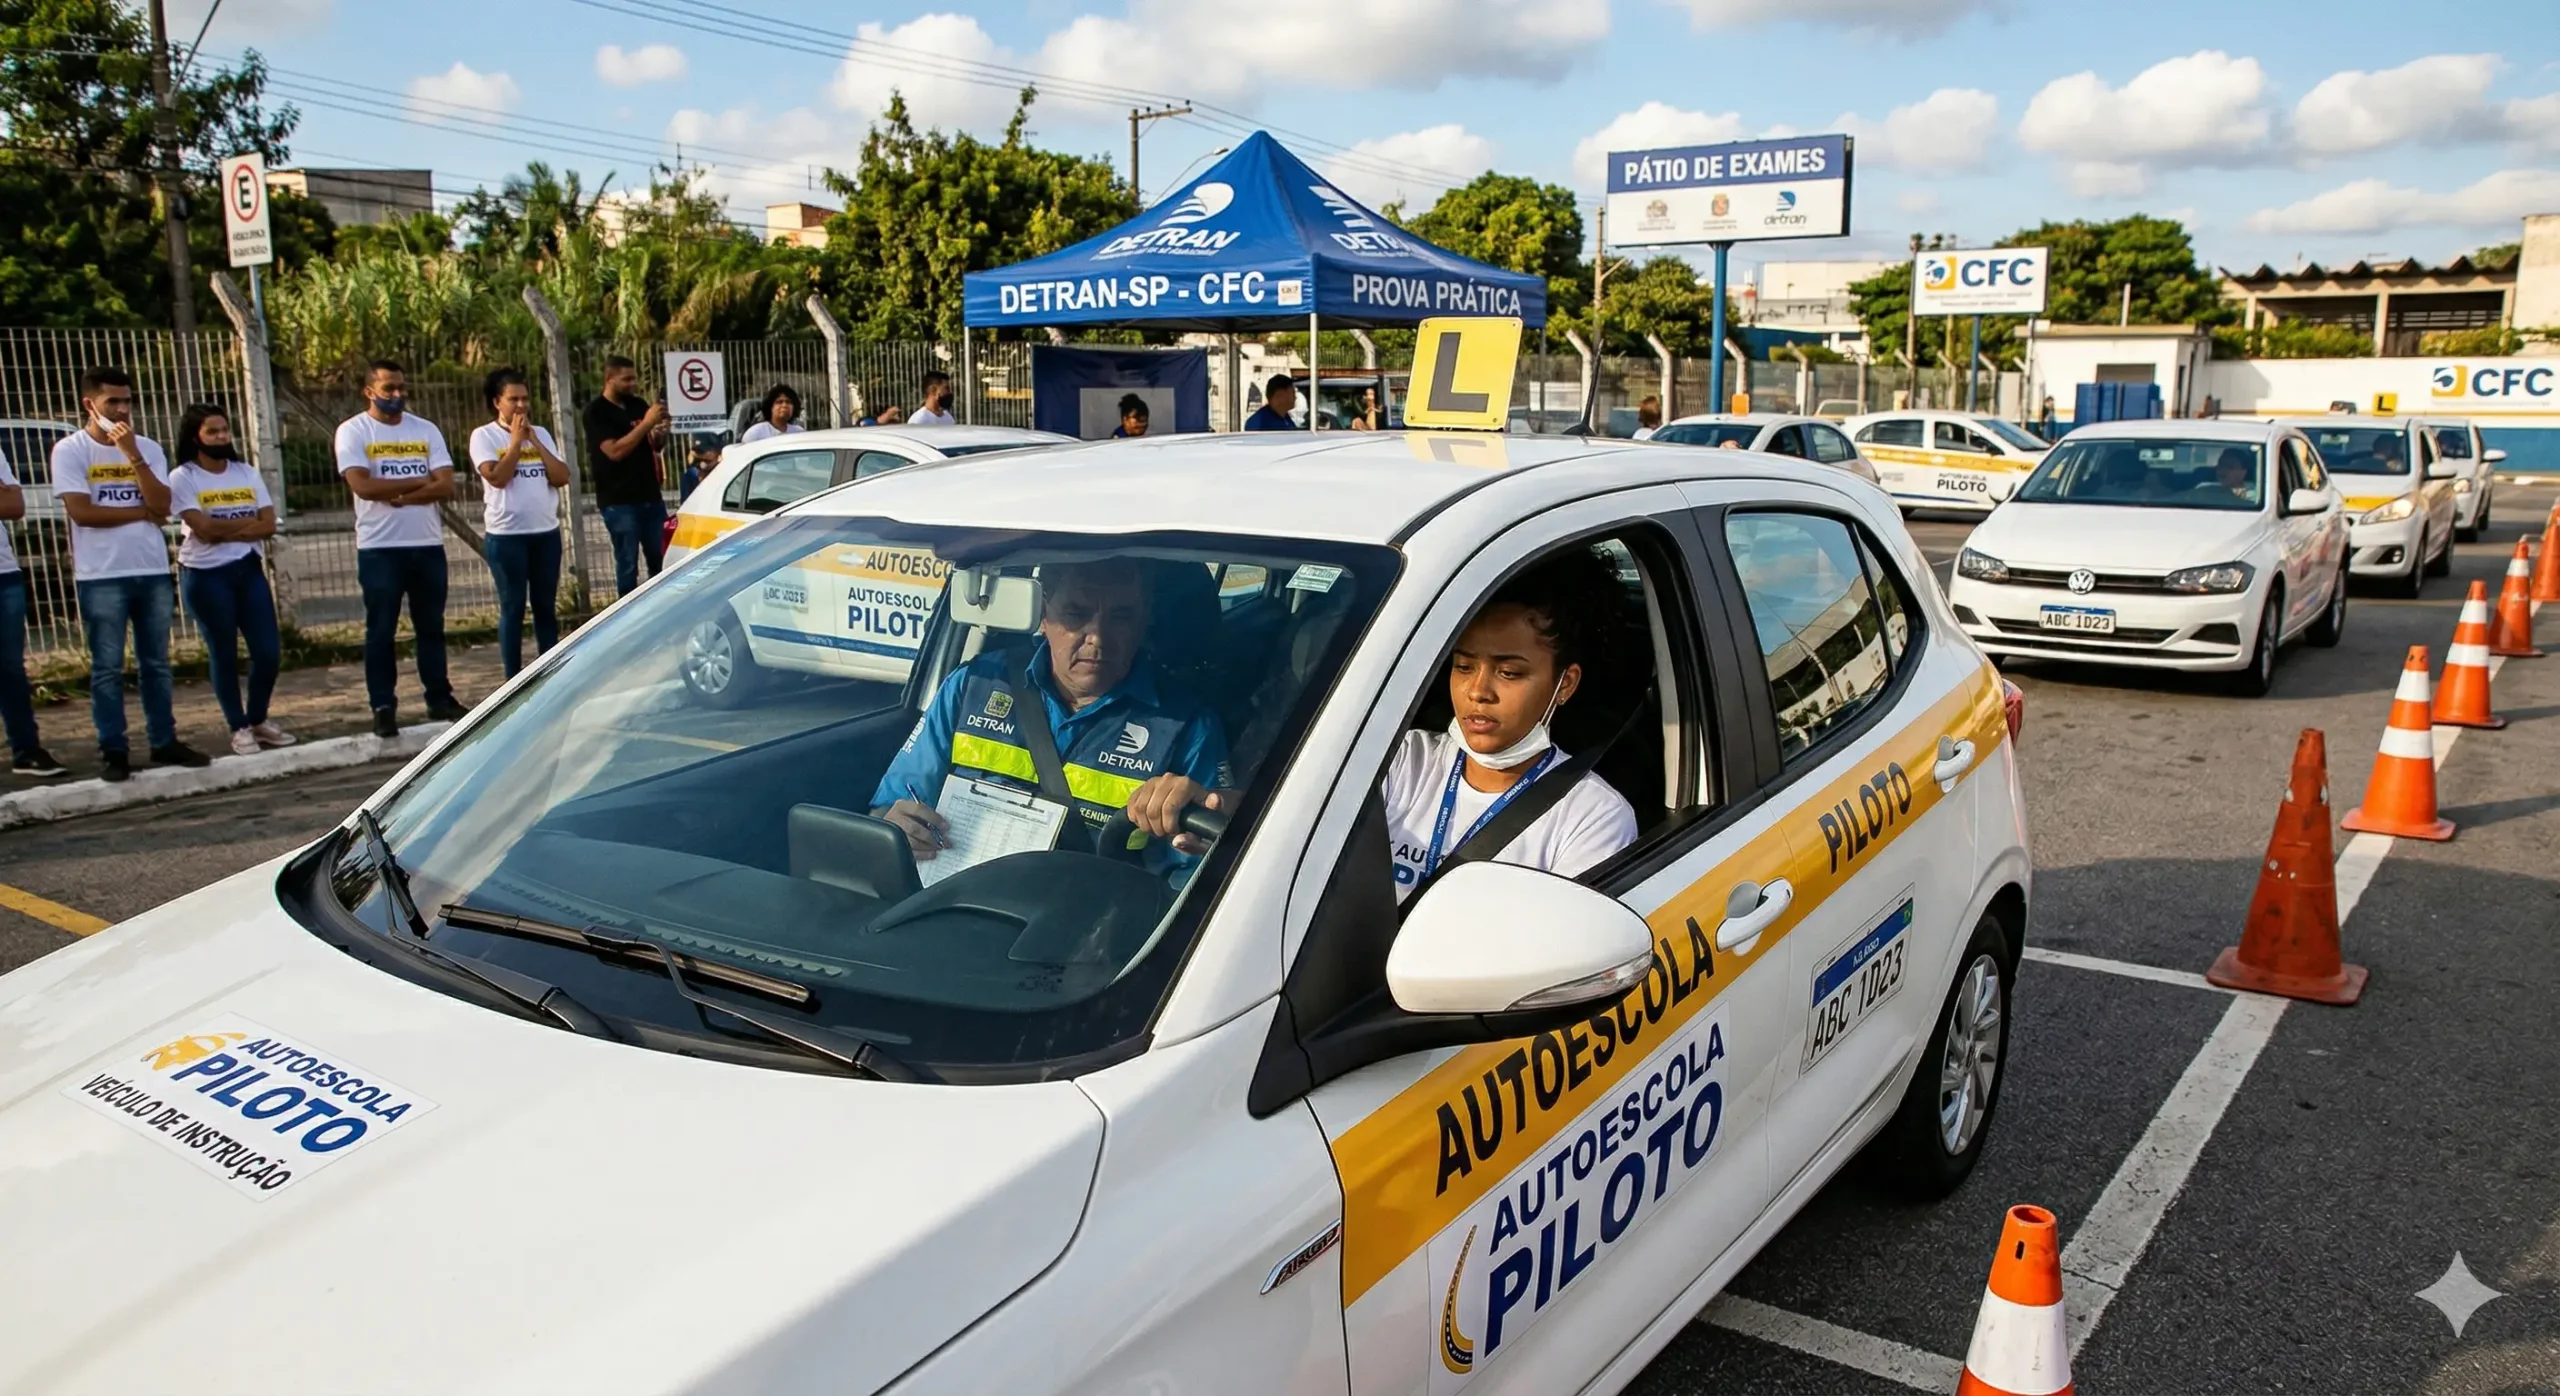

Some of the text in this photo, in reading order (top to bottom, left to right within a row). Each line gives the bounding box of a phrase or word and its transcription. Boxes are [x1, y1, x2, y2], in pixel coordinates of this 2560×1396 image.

[1624, 148, 1826, 185] PÁTIO DE EXAMES
[238, 175, 252, 209] E
[1099, 227, 1241, 254] DETRAN
[1961, 258, 2034, 287] CFC
[1000, 275, 1170, 314] DETRAN-SP
[1198, 271, 1265, 305] CFC
[1353, 274, 1522, 316] PROVA PRÁTICA
[688, 368, 705, 392] E
[1427, 332, 1490, 413] L
[2472, 368, 2554, 397] CFC
[2376, 396, 2394, 412] L
[381, 464, 427, 476] PILOTO
[1937, 479, 1987, 493] PILOTO
[97, 489, 143, 502] PILOT
[2045, 613, 2110, 630] ABC 1D23
[966, 714, 1015, 735] DETRAN
[1098, 751, 1155, 773] DETRAN
[1818, 762, 1912, 875] PILOTO
[1810, 938, 1904, 1061] ABC 1D23
[1435, 915, 1715, 1199] AUTOESCOLA
[236, 1038, 413, 1125] AUTOESCOLA
[169, 1053, 369, 1154] PILOTO
[80, 1072, 293, 1191] VEÍCULO DE INSTRUÇÃO
[1489, 1022, 1726, 1256] AUTOESCOLA
[1484, 1081, 1724, 1359] PILOTO
